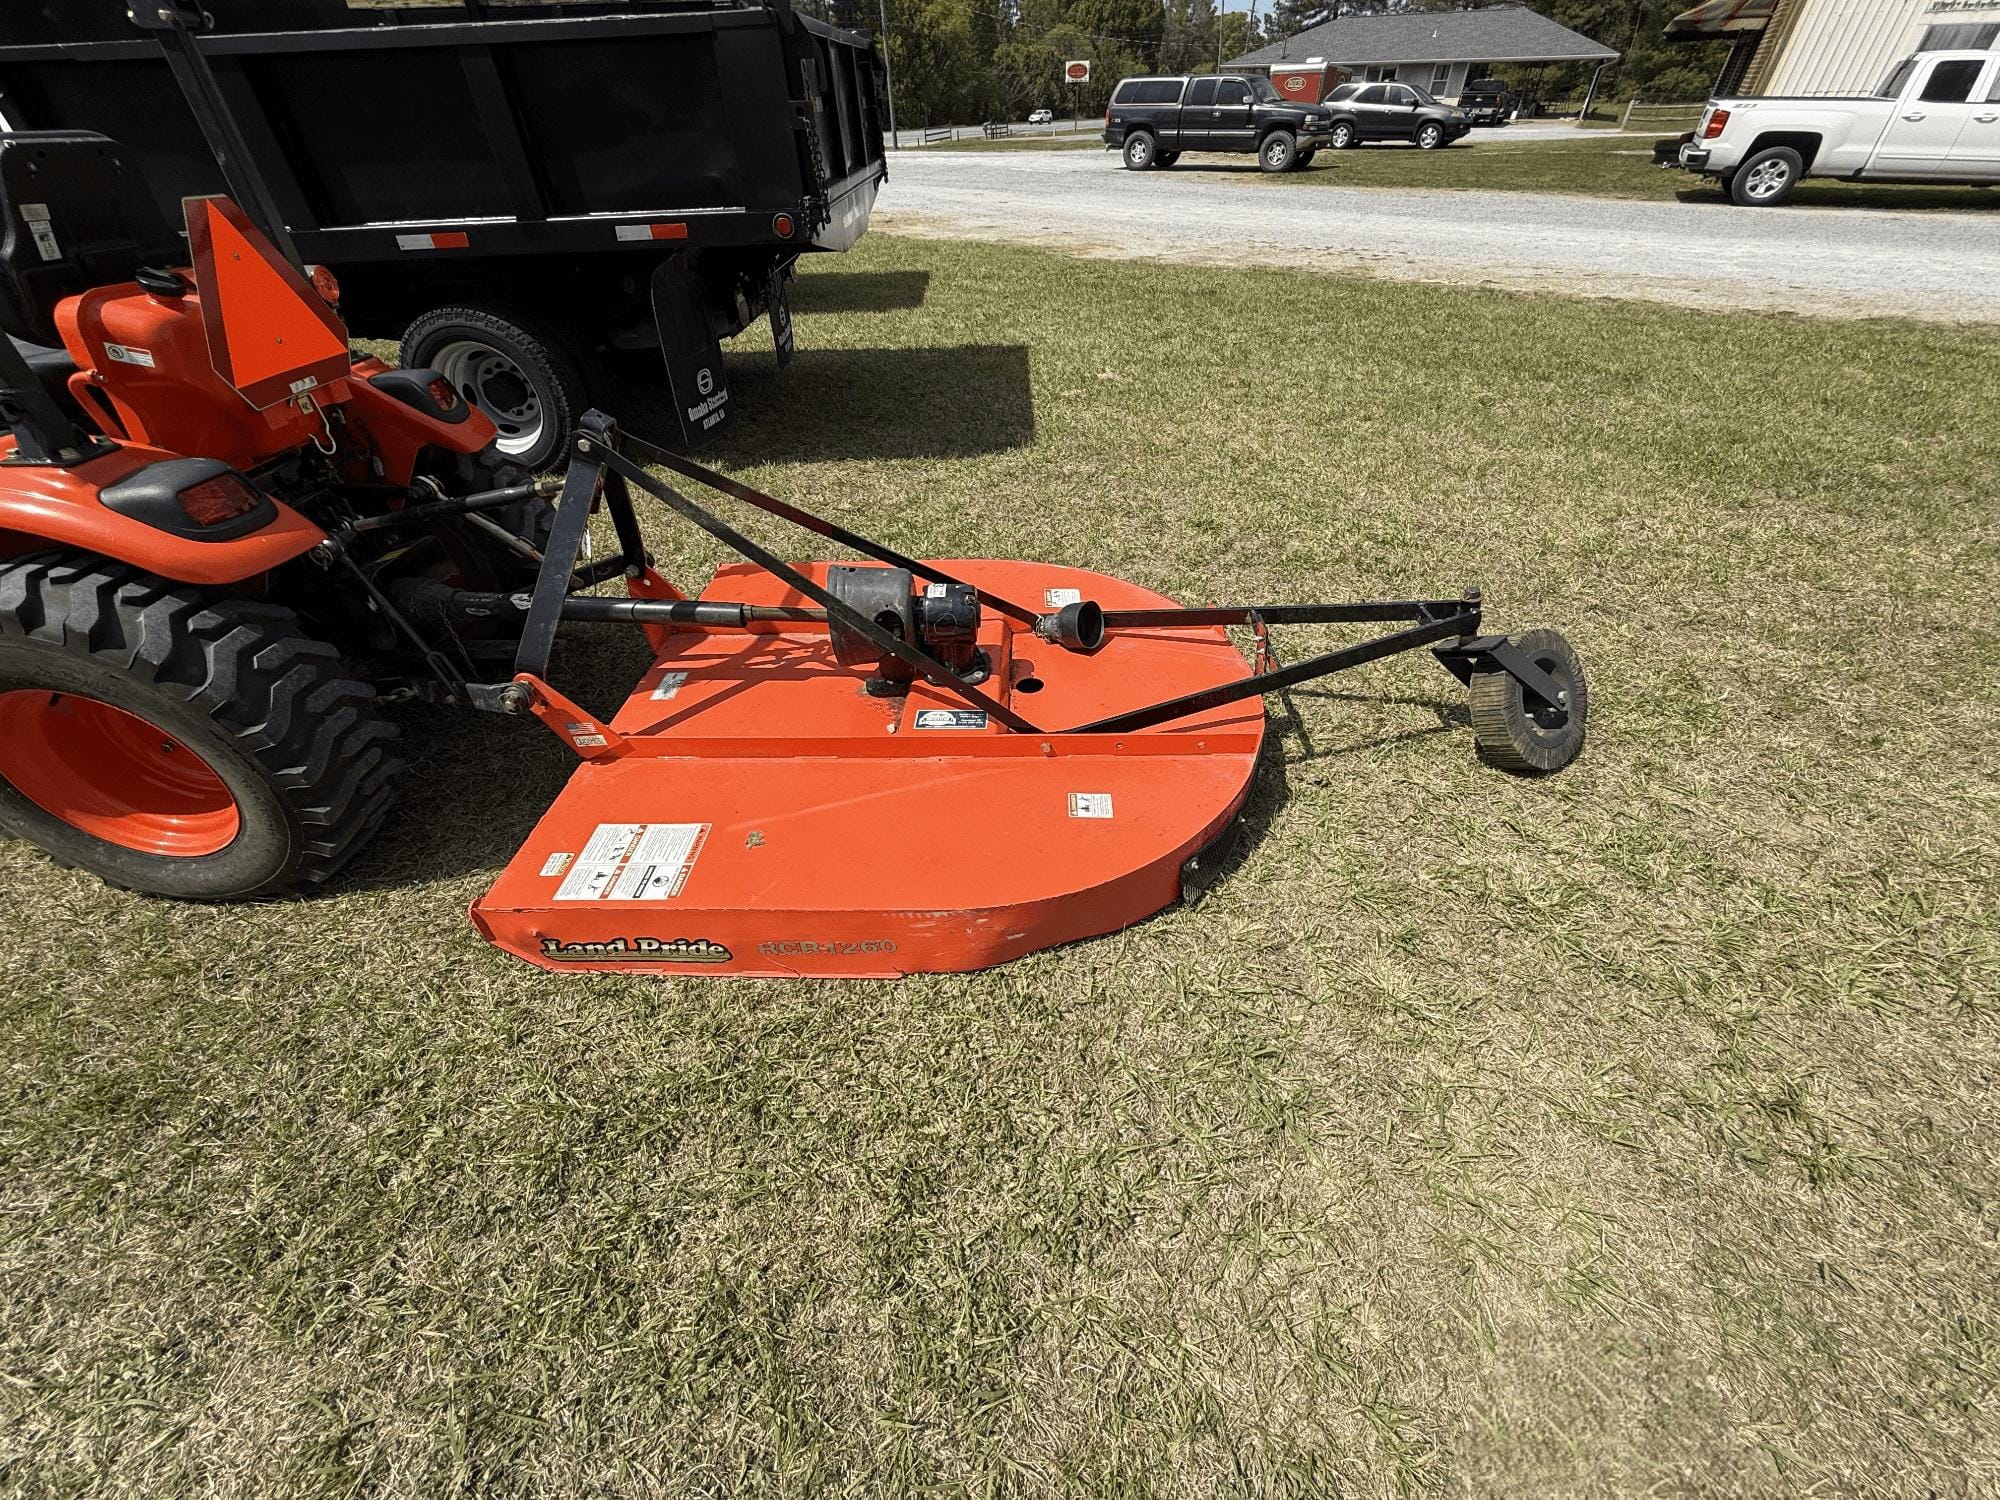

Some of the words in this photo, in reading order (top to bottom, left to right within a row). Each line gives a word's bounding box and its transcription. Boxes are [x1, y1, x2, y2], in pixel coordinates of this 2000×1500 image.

[541, 938, 627, 957] Land
[635, 938, 729, 958] Pride
[758, 940, 898, 955] RCR1260
